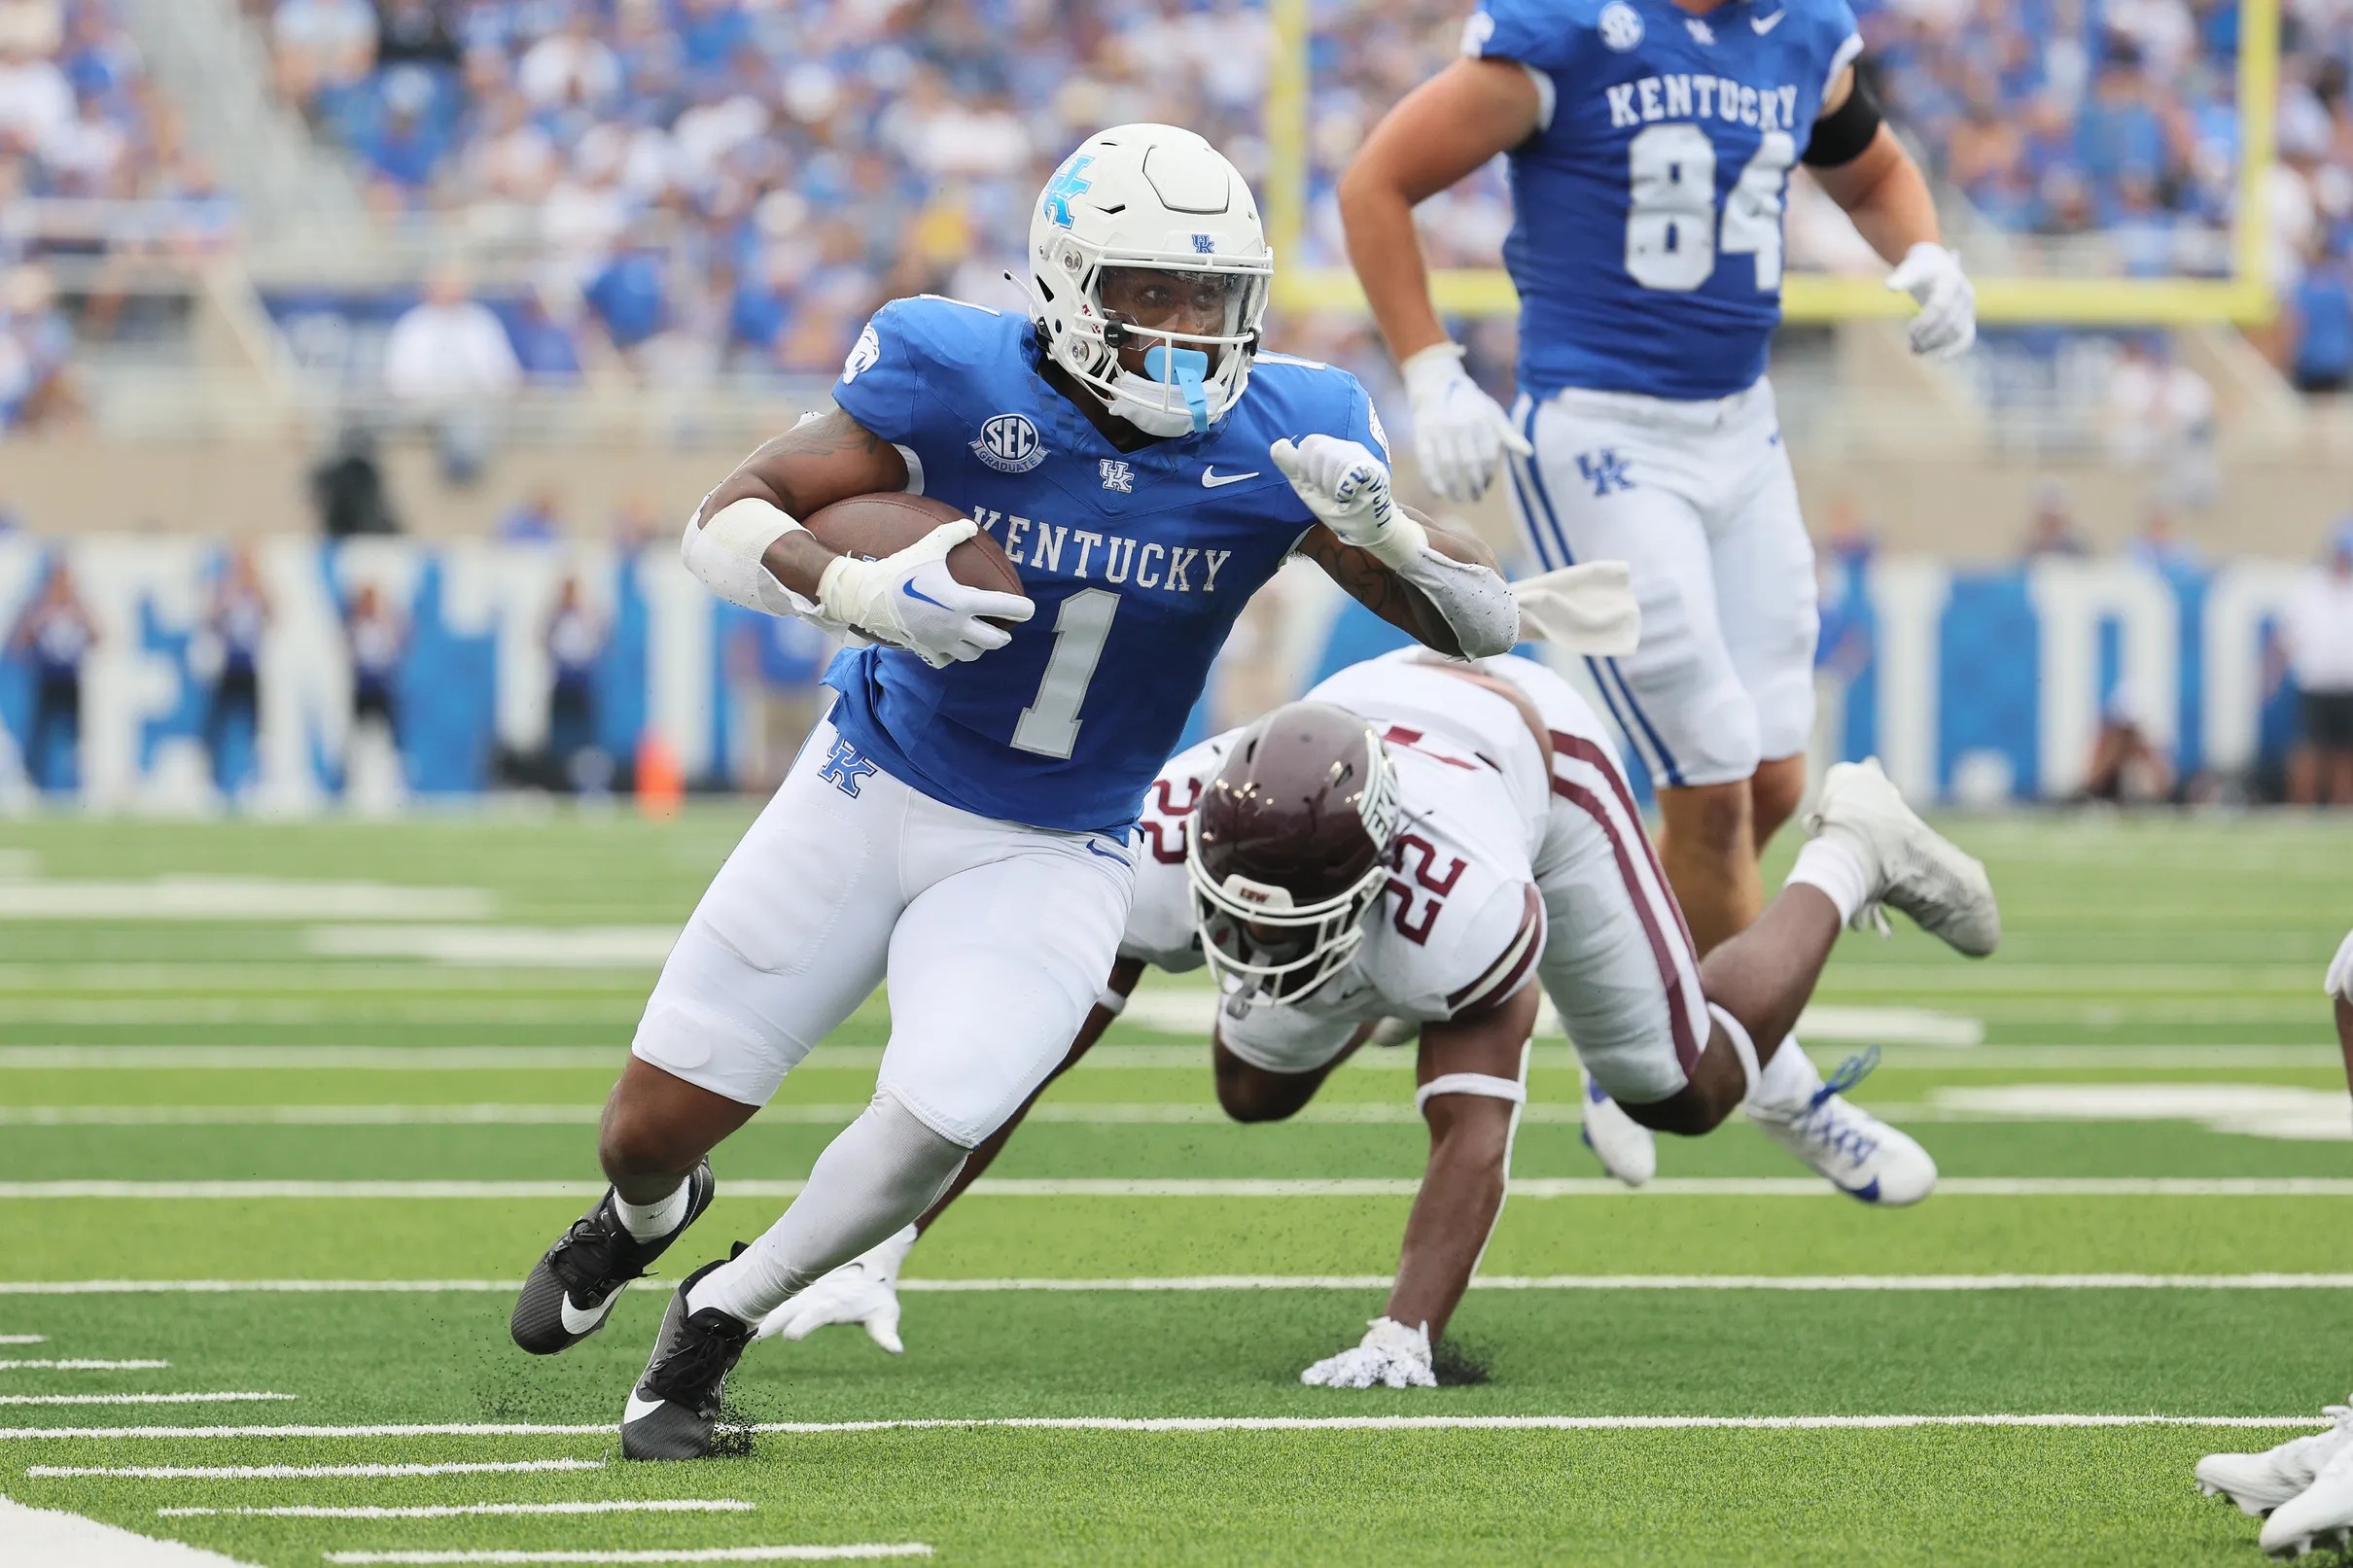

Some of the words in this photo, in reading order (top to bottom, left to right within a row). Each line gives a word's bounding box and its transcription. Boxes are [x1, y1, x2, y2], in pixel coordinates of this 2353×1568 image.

[1605, 73, 1798, 130] KENTUCKY
[1625, 123, 1796, 293] 84
[1192, 233, 1215, 254] UK
[978, 450, 1037, 473] GRADUATE
[985, 417, 1034, 459] SEC
[1099, 458, 1135, 493] UK
[1574, 448, 1636, 497] UK
[973, 505, 1232, 592] KENTUCKY
[1009, 586, 1122, 760] 1
[1385, 833, 1468, 948] 22
